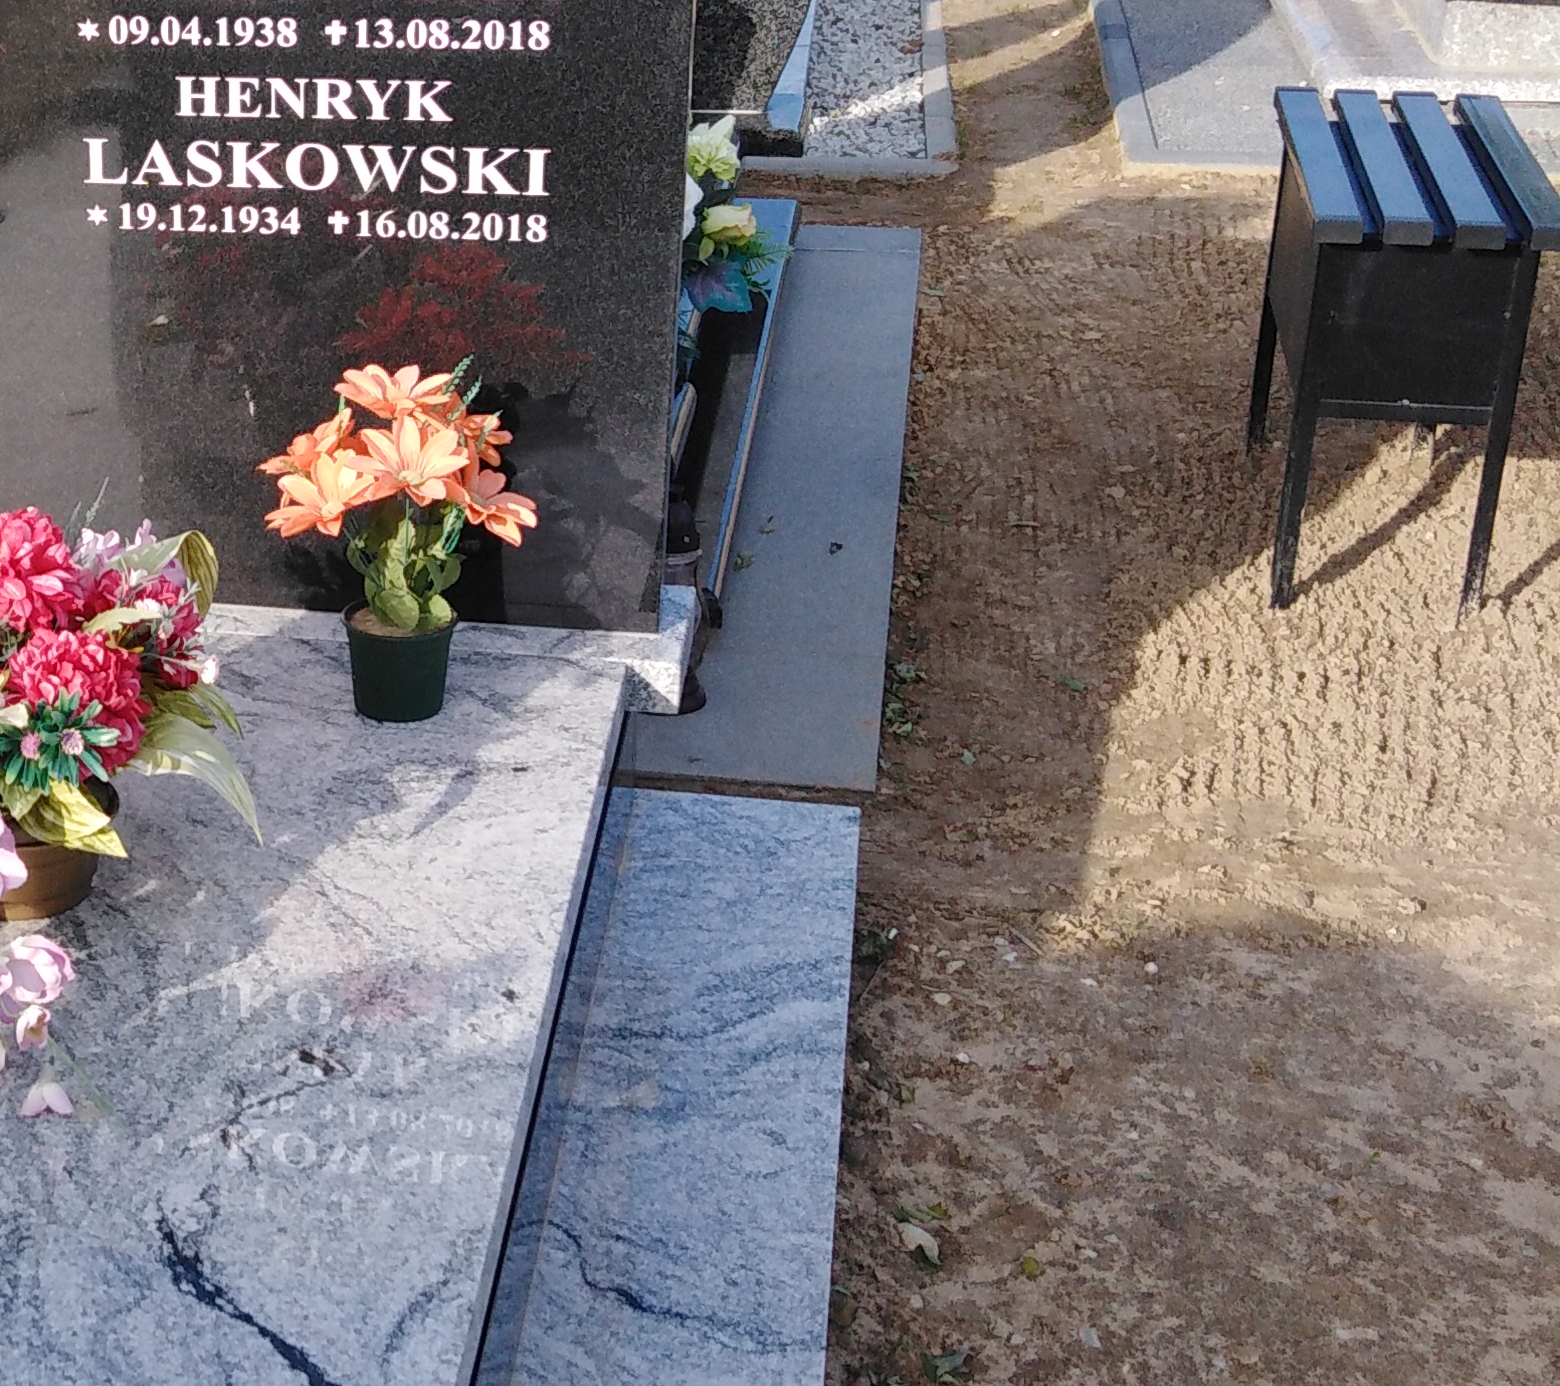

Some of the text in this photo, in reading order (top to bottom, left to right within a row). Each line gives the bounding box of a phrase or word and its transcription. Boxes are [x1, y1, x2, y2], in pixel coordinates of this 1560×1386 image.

[107, 15, 551, 51] 09.04.1938 13.08.2018
[175, 75, 454, 123] HENRYK
[82, 137, 552, 197] LASKOWSKI
[117, 202, 548, 244] 19.12.1934 16.08.2018
